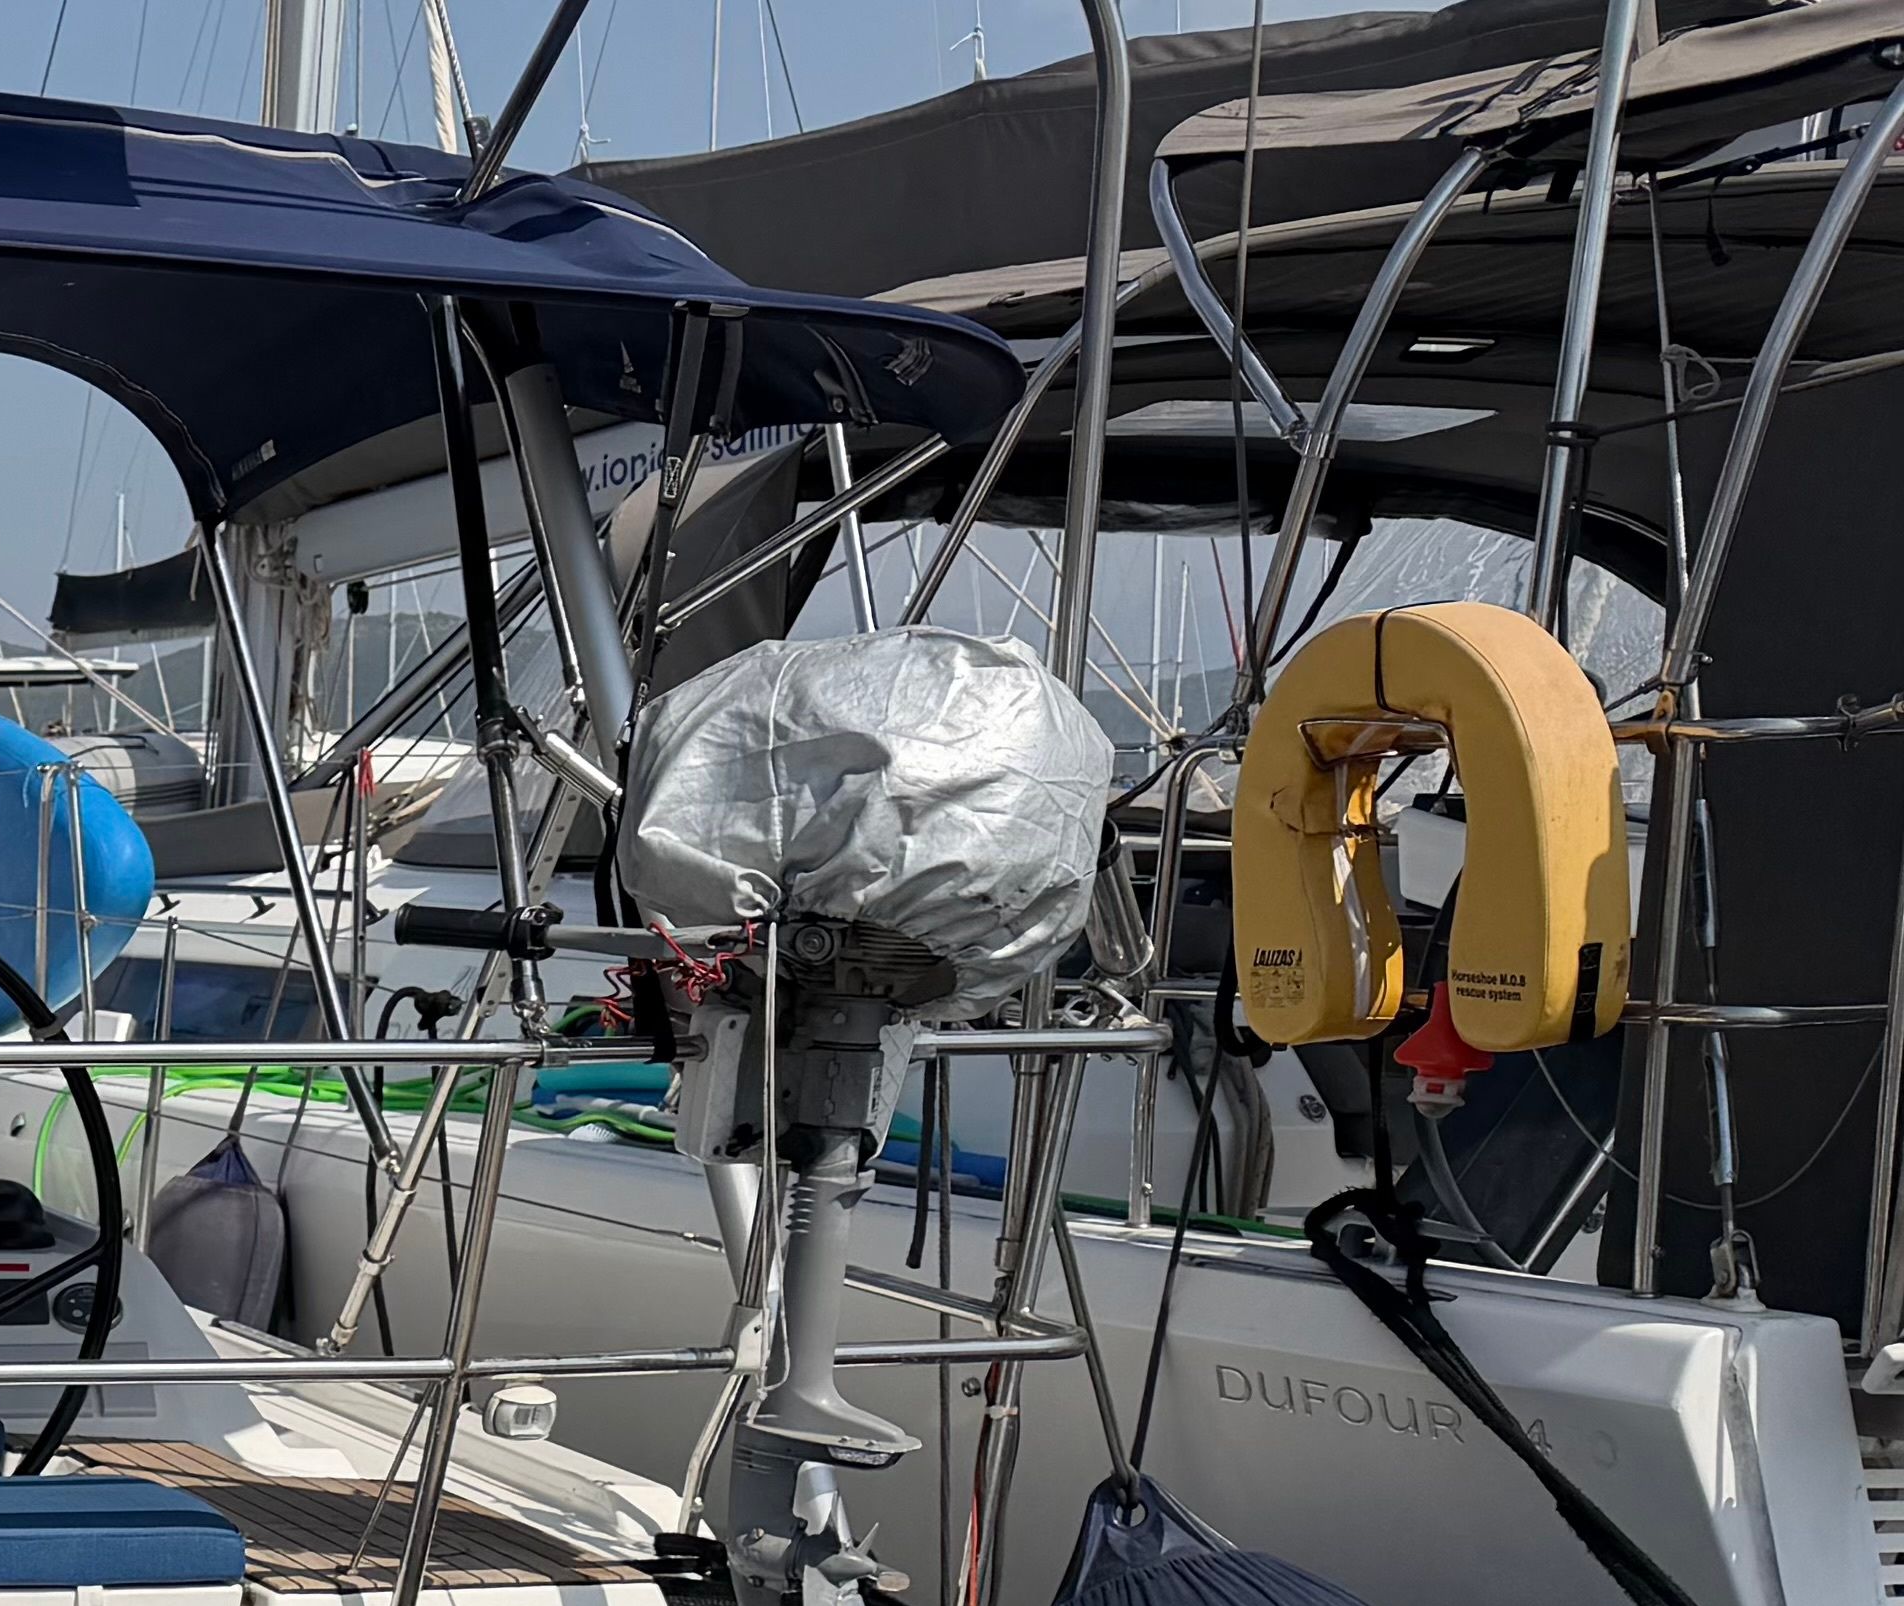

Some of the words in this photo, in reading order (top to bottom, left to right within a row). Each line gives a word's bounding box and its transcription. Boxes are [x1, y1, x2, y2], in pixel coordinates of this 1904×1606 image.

[1253, 948, 1296, 967] LALIZAS
[1456, 986, 1486, 998] rescue
[1488, 989, 1522, 1002] system
[1215, 1364, 1465, 1444] DUFOUR
